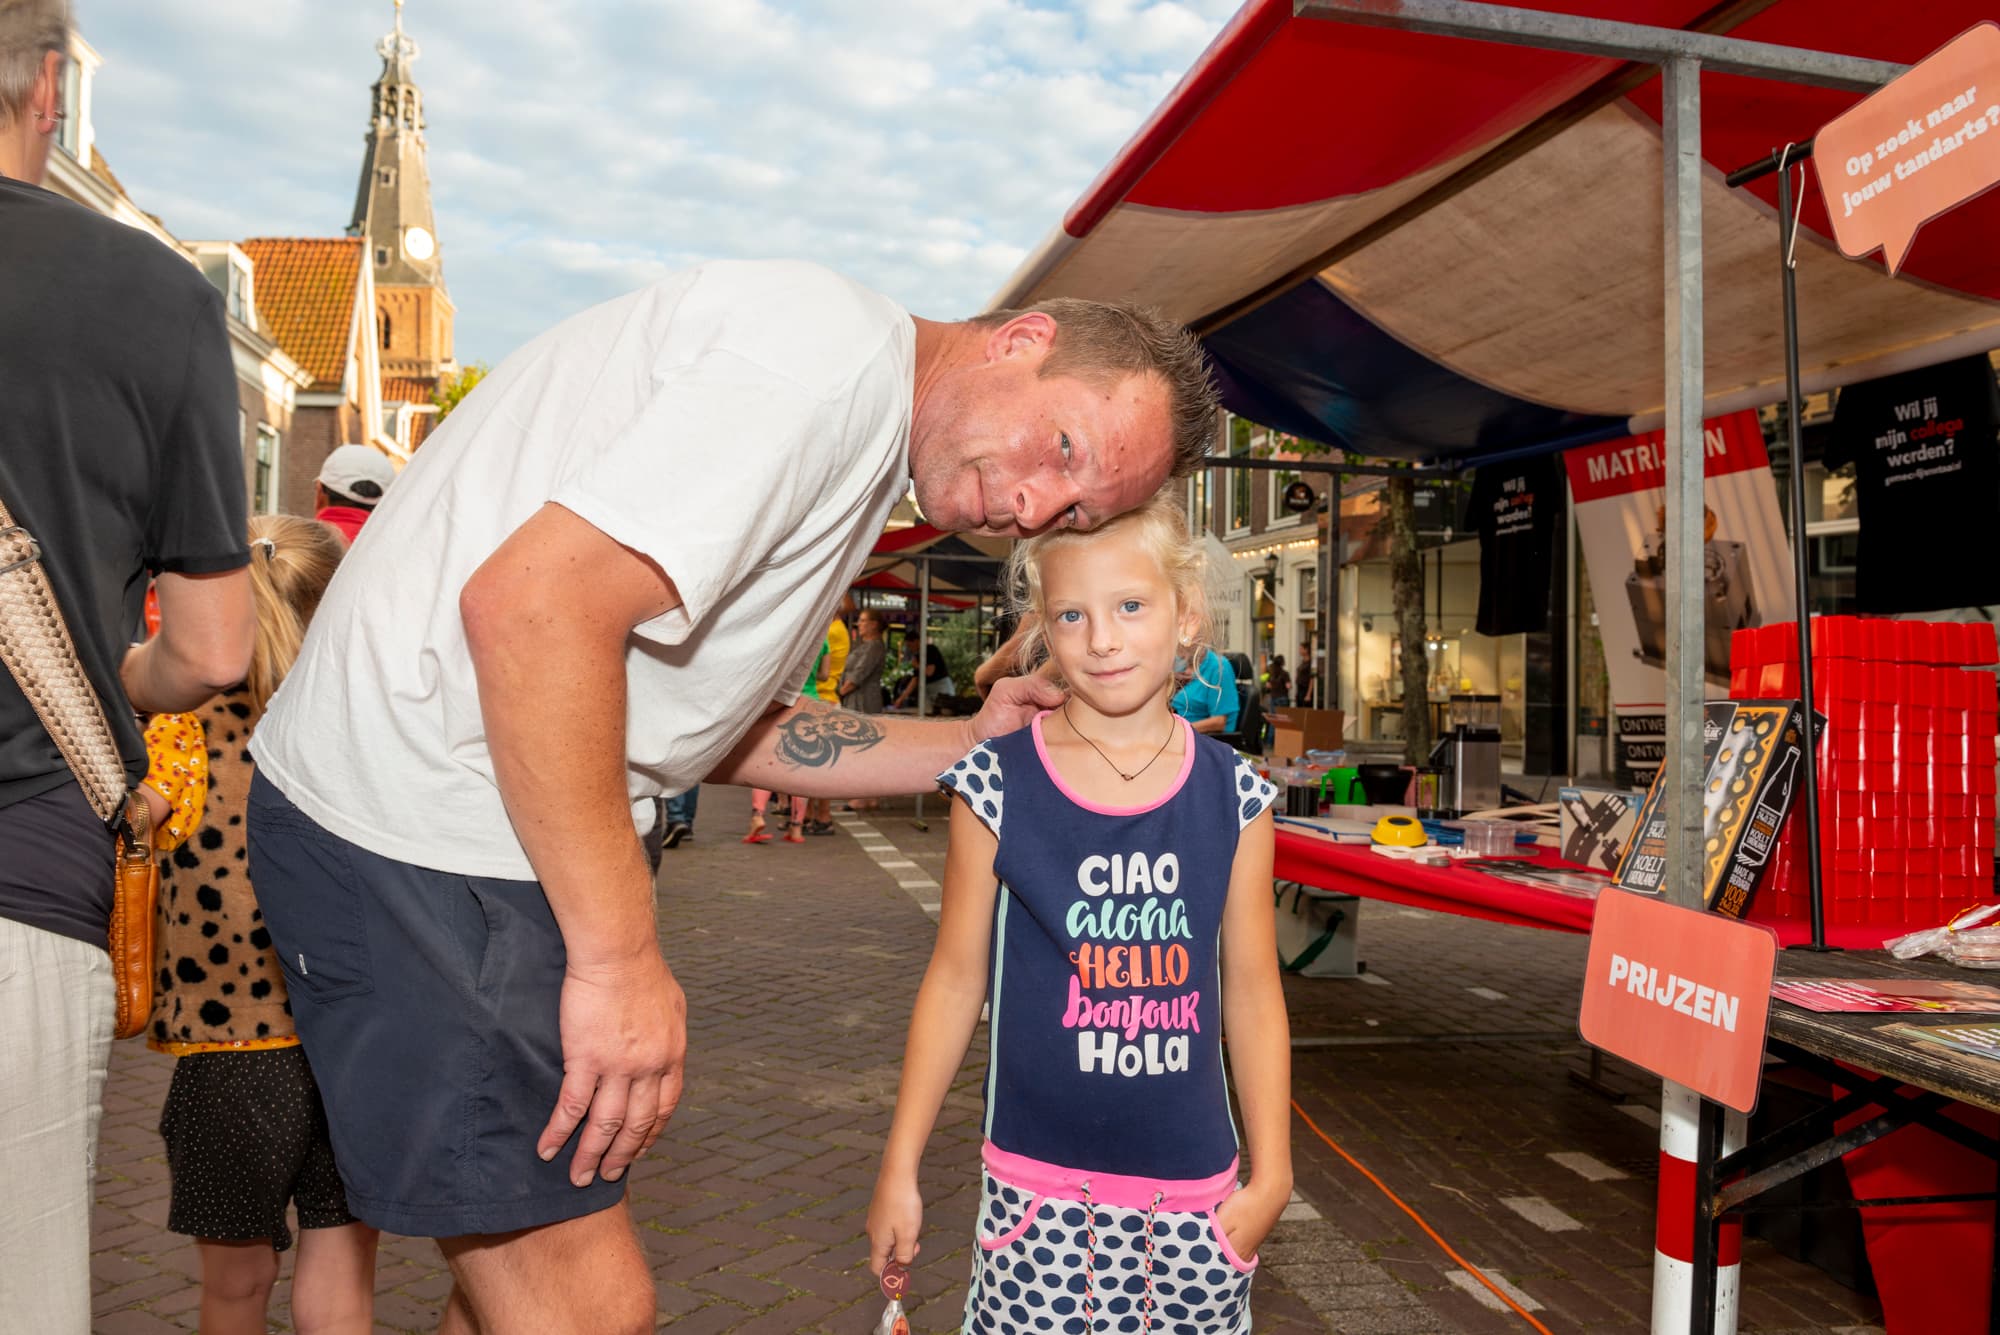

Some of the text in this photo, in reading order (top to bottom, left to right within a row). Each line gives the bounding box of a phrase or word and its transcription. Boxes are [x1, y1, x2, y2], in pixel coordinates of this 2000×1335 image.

[1845, 85, 1977, 177] Op zoek naar
[1842, 105, 2000, 217] jouw tandarts?
[1894, 396, 1939, 422] Wil jij
[1586, 427, 1727, 483] MATRIN
[1875, 428, 1908, 450] mijn
[1887, 438, 1955, 467] worden?
[1621, 718, 1665, 732] ONTWE
[1627, 744, 1665, 758] ONTW
[1077, 851, 1180, 897] CIAO
[1632, 854, 1666, 873] KOELT
[1724, 882, 1748, 905] VOOR
[1066, 897, 1193, 941] aloha
[1069, 942, 1190, 989] HELLO
[1608, 953, 1740, 1033] PRIJZEN
